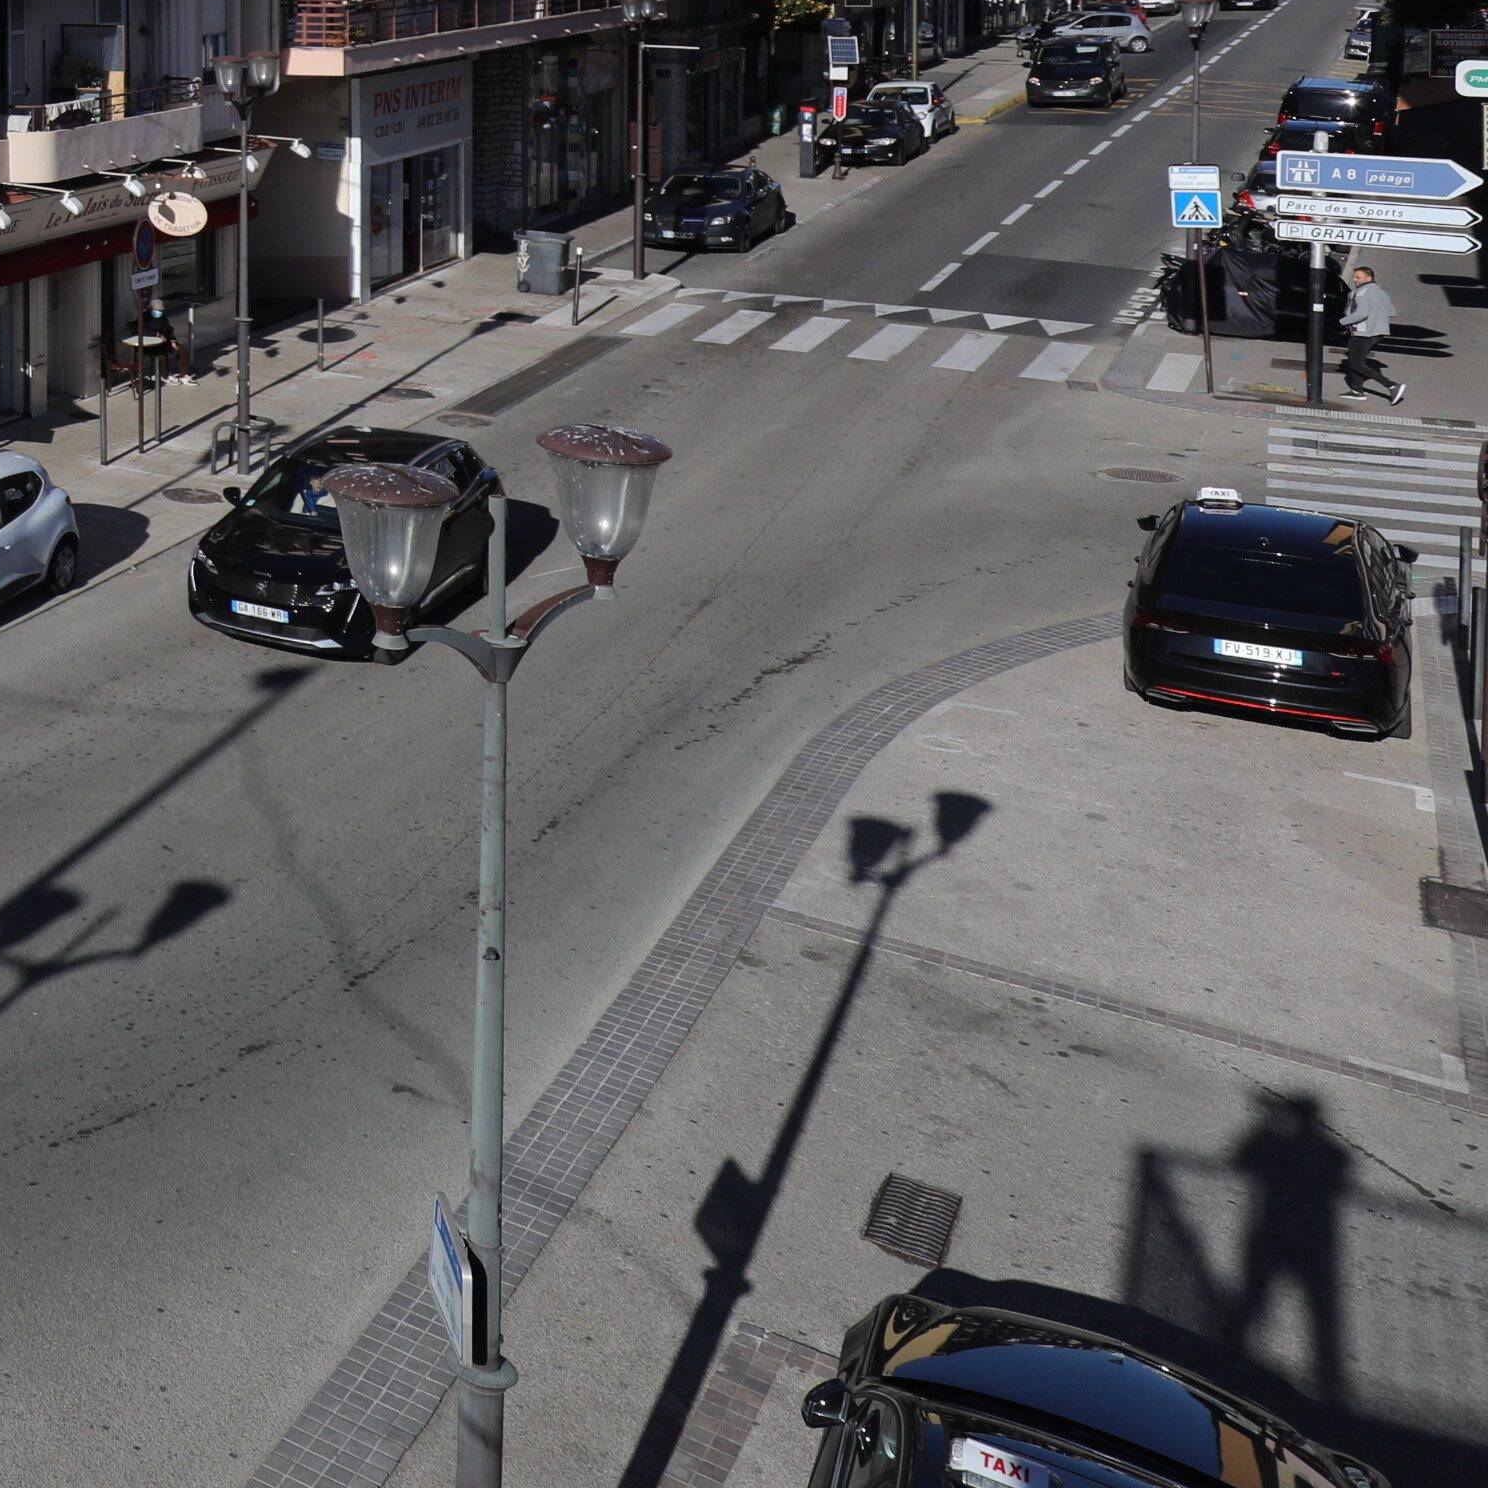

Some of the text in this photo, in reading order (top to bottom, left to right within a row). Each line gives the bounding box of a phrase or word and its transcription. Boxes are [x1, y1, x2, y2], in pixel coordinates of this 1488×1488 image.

[374, 77, 461, 117] PNS INTERIM
[1332, 168, 1411, 186] A 8 péage
[1286, 200, 1405, 219] Parc des Sports
[44, 212, 60, 230] Le
[164, 219, 203, 232] TRADITION
[1310, 228, 1386, 243] GRATUIT
[980, 1451, 1030, 1484] TAXI
